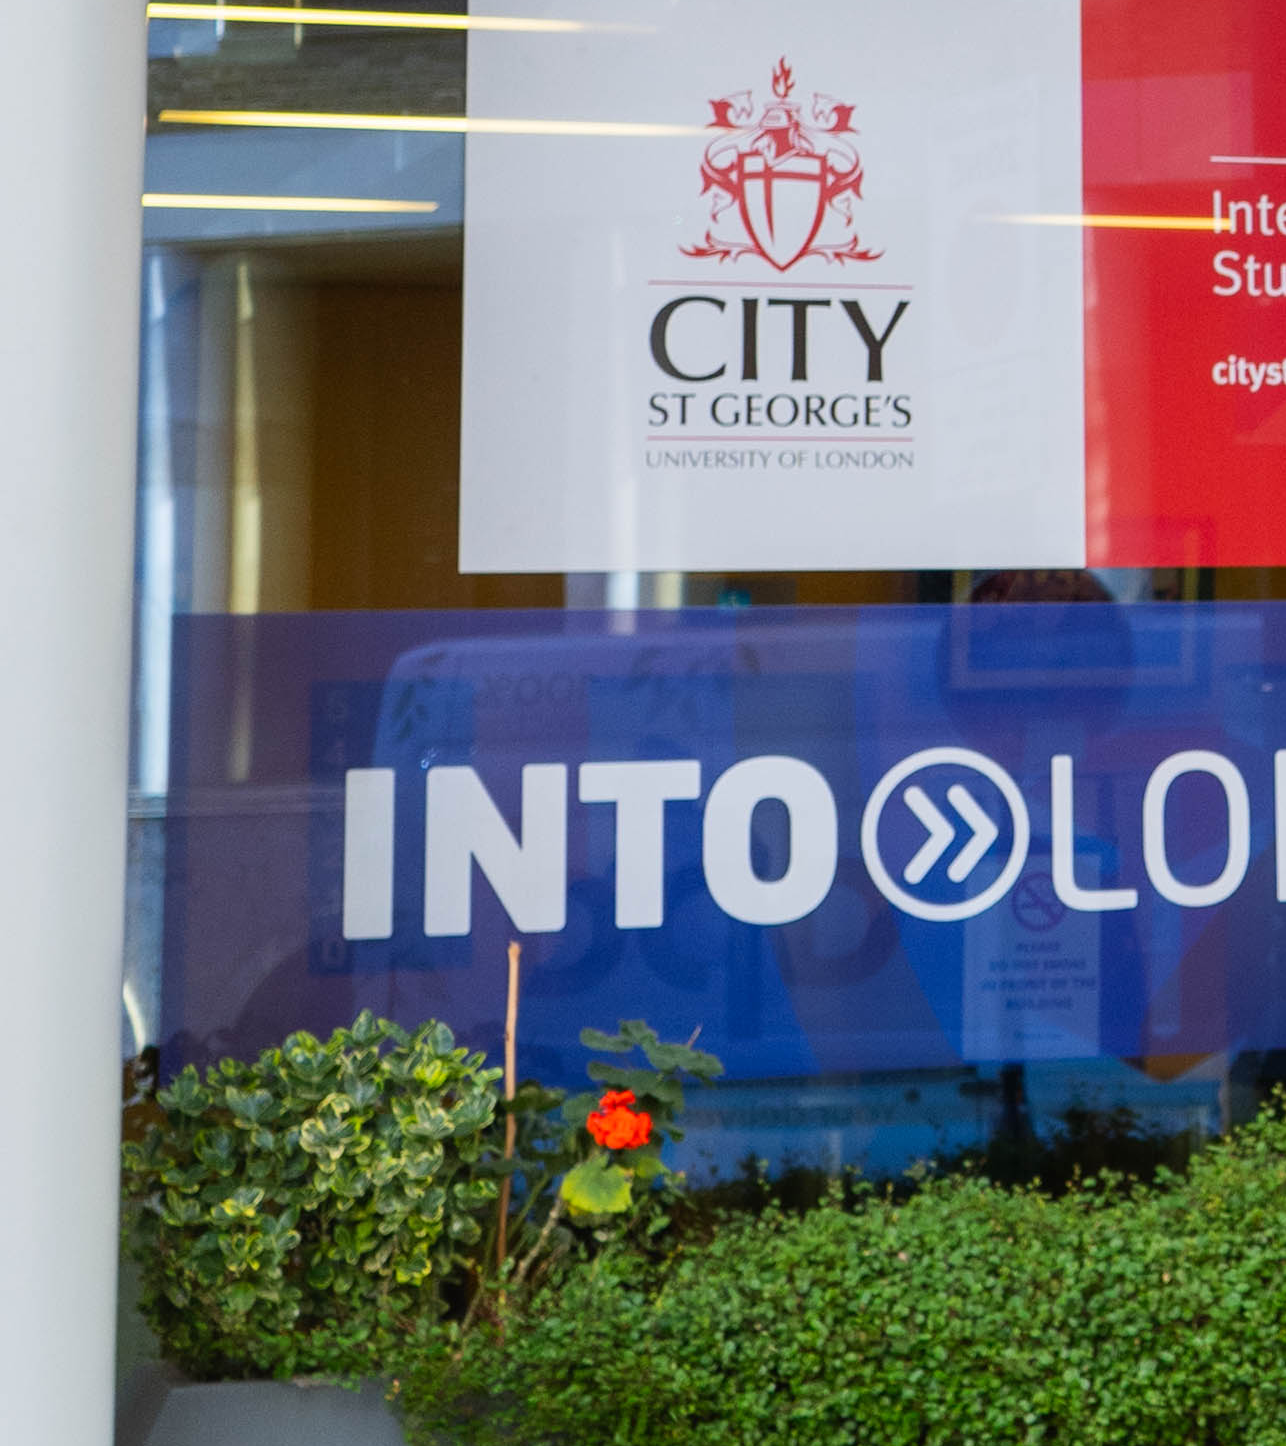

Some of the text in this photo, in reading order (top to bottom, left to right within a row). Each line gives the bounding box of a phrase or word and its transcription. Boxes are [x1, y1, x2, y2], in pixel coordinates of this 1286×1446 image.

[649, 296, 910, 383] CITY
[649, 393, 911, 427] ST GEORGE'S
[645, 449, 914, 470] UNIVERSITY OF LONDON
[343, 755, 838, 941] INTO
